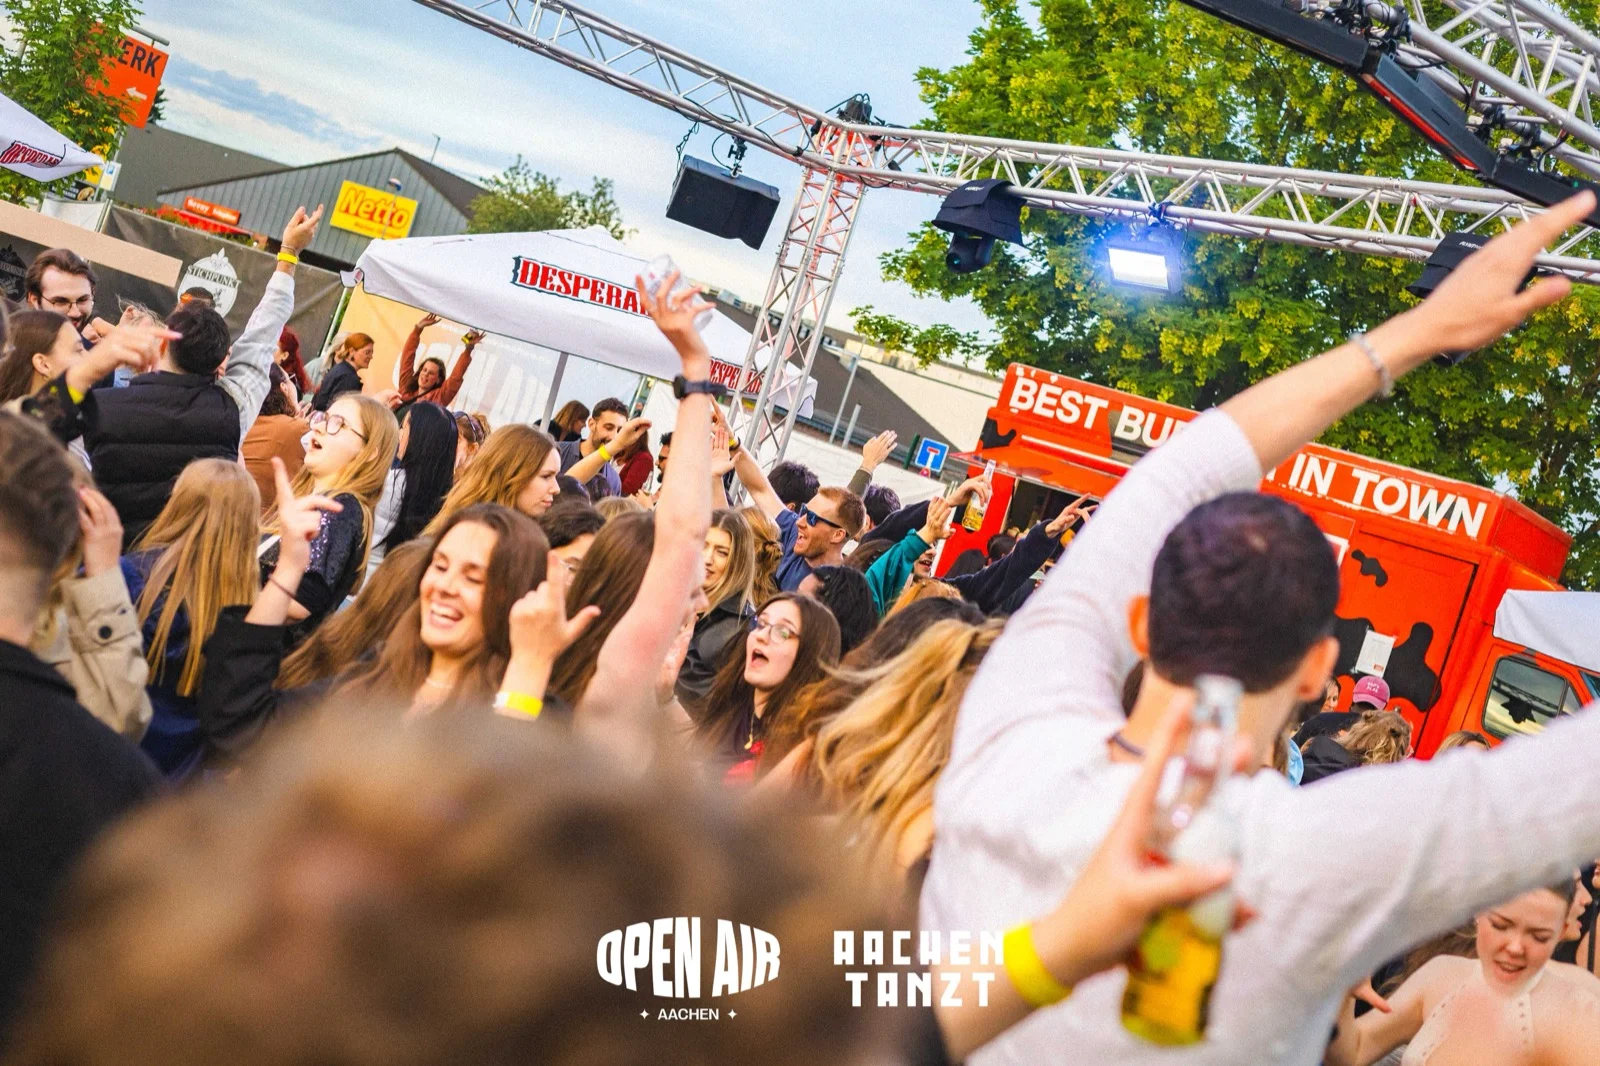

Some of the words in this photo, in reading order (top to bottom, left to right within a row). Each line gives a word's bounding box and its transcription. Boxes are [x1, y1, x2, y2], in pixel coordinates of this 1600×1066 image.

[112, 39, 161, 78] ERK
[339, 187, 411, 230] Netto
[187, 265, 242, 288] STICHPUNKT
[519, 259, 651, 316] DESPERA
[1009, 377, 1109, 429] BEST
[1288, 453, 1337, 495] IN
[1351, 468, 1488, 537] TOWN
